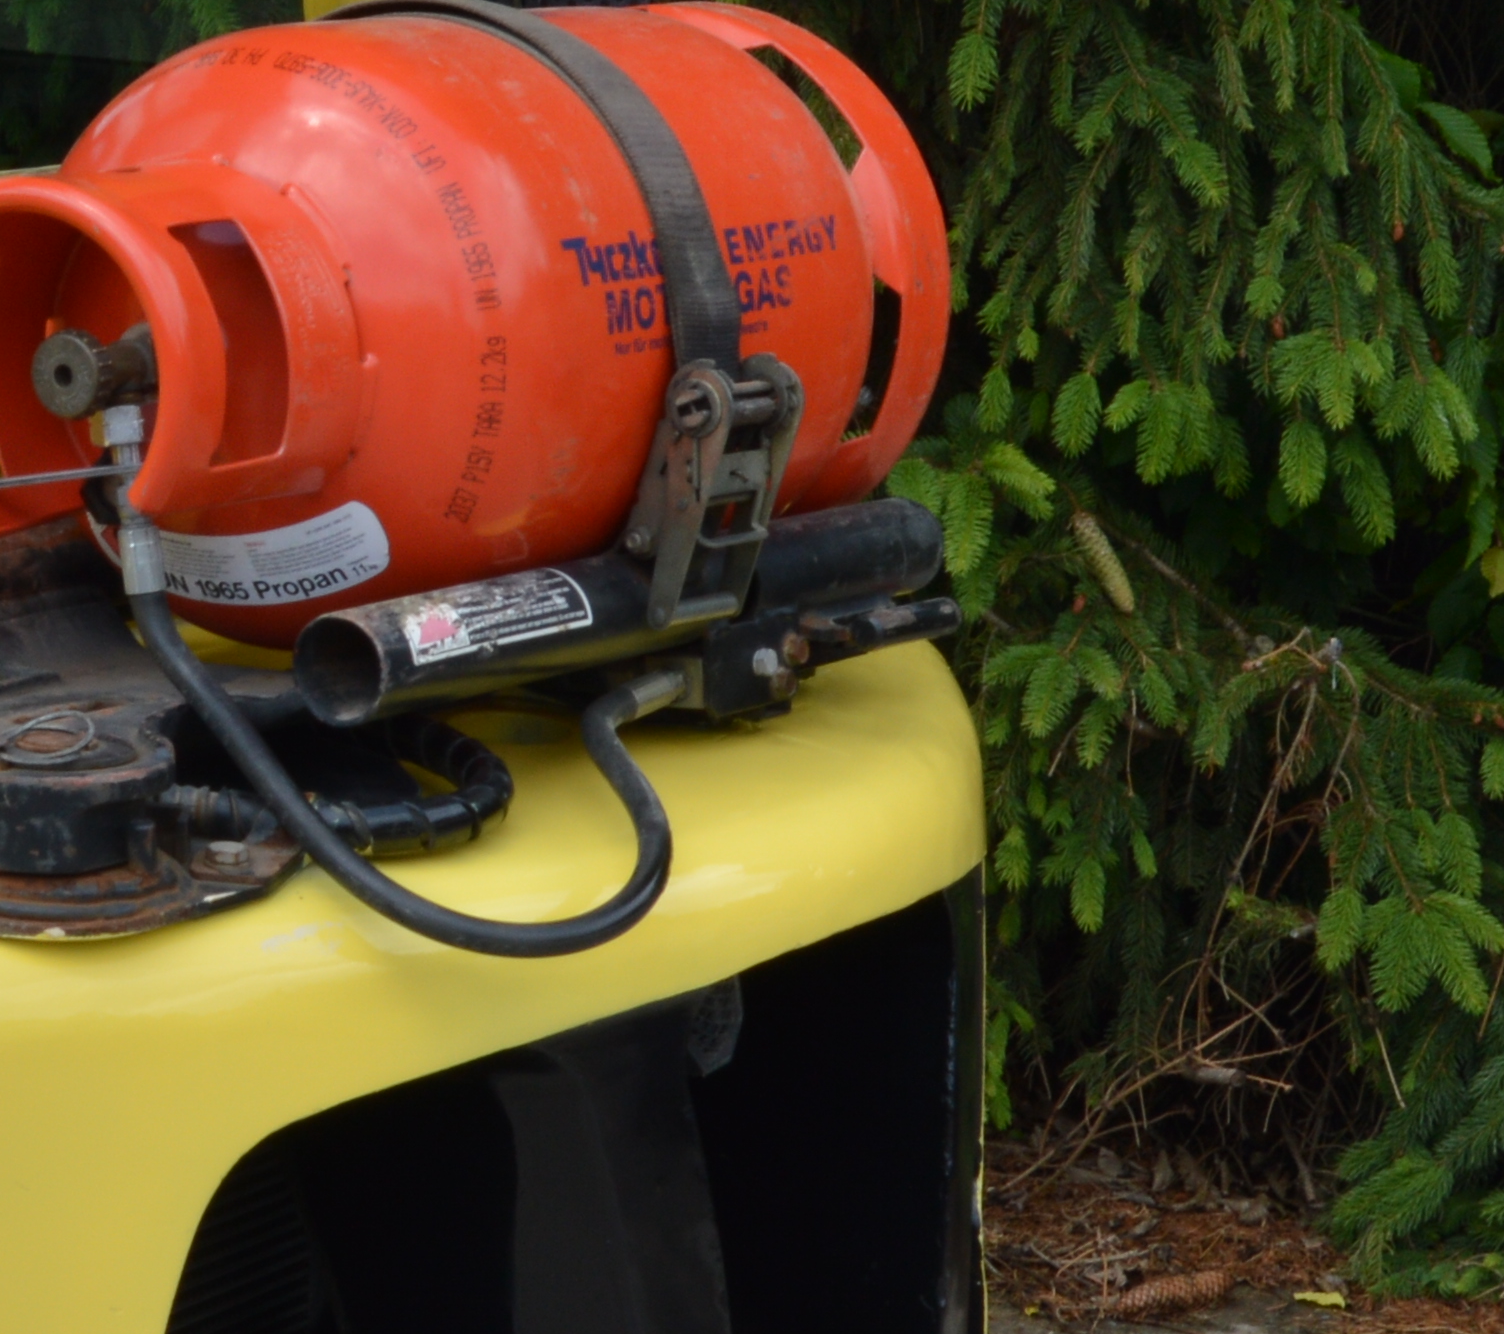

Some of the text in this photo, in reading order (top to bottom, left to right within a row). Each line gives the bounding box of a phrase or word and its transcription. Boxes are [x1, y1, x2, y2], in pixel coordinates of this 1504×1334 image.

[437, 181, 482, 240] PROPAN
[723, 214, 837, 265] ENERGY
[734, 265, 792, 314] GAS
[473, 401, 504, 438] TARA
[195, 578, 251, 601] 1965
[251, 566, 349, 600] Propan
